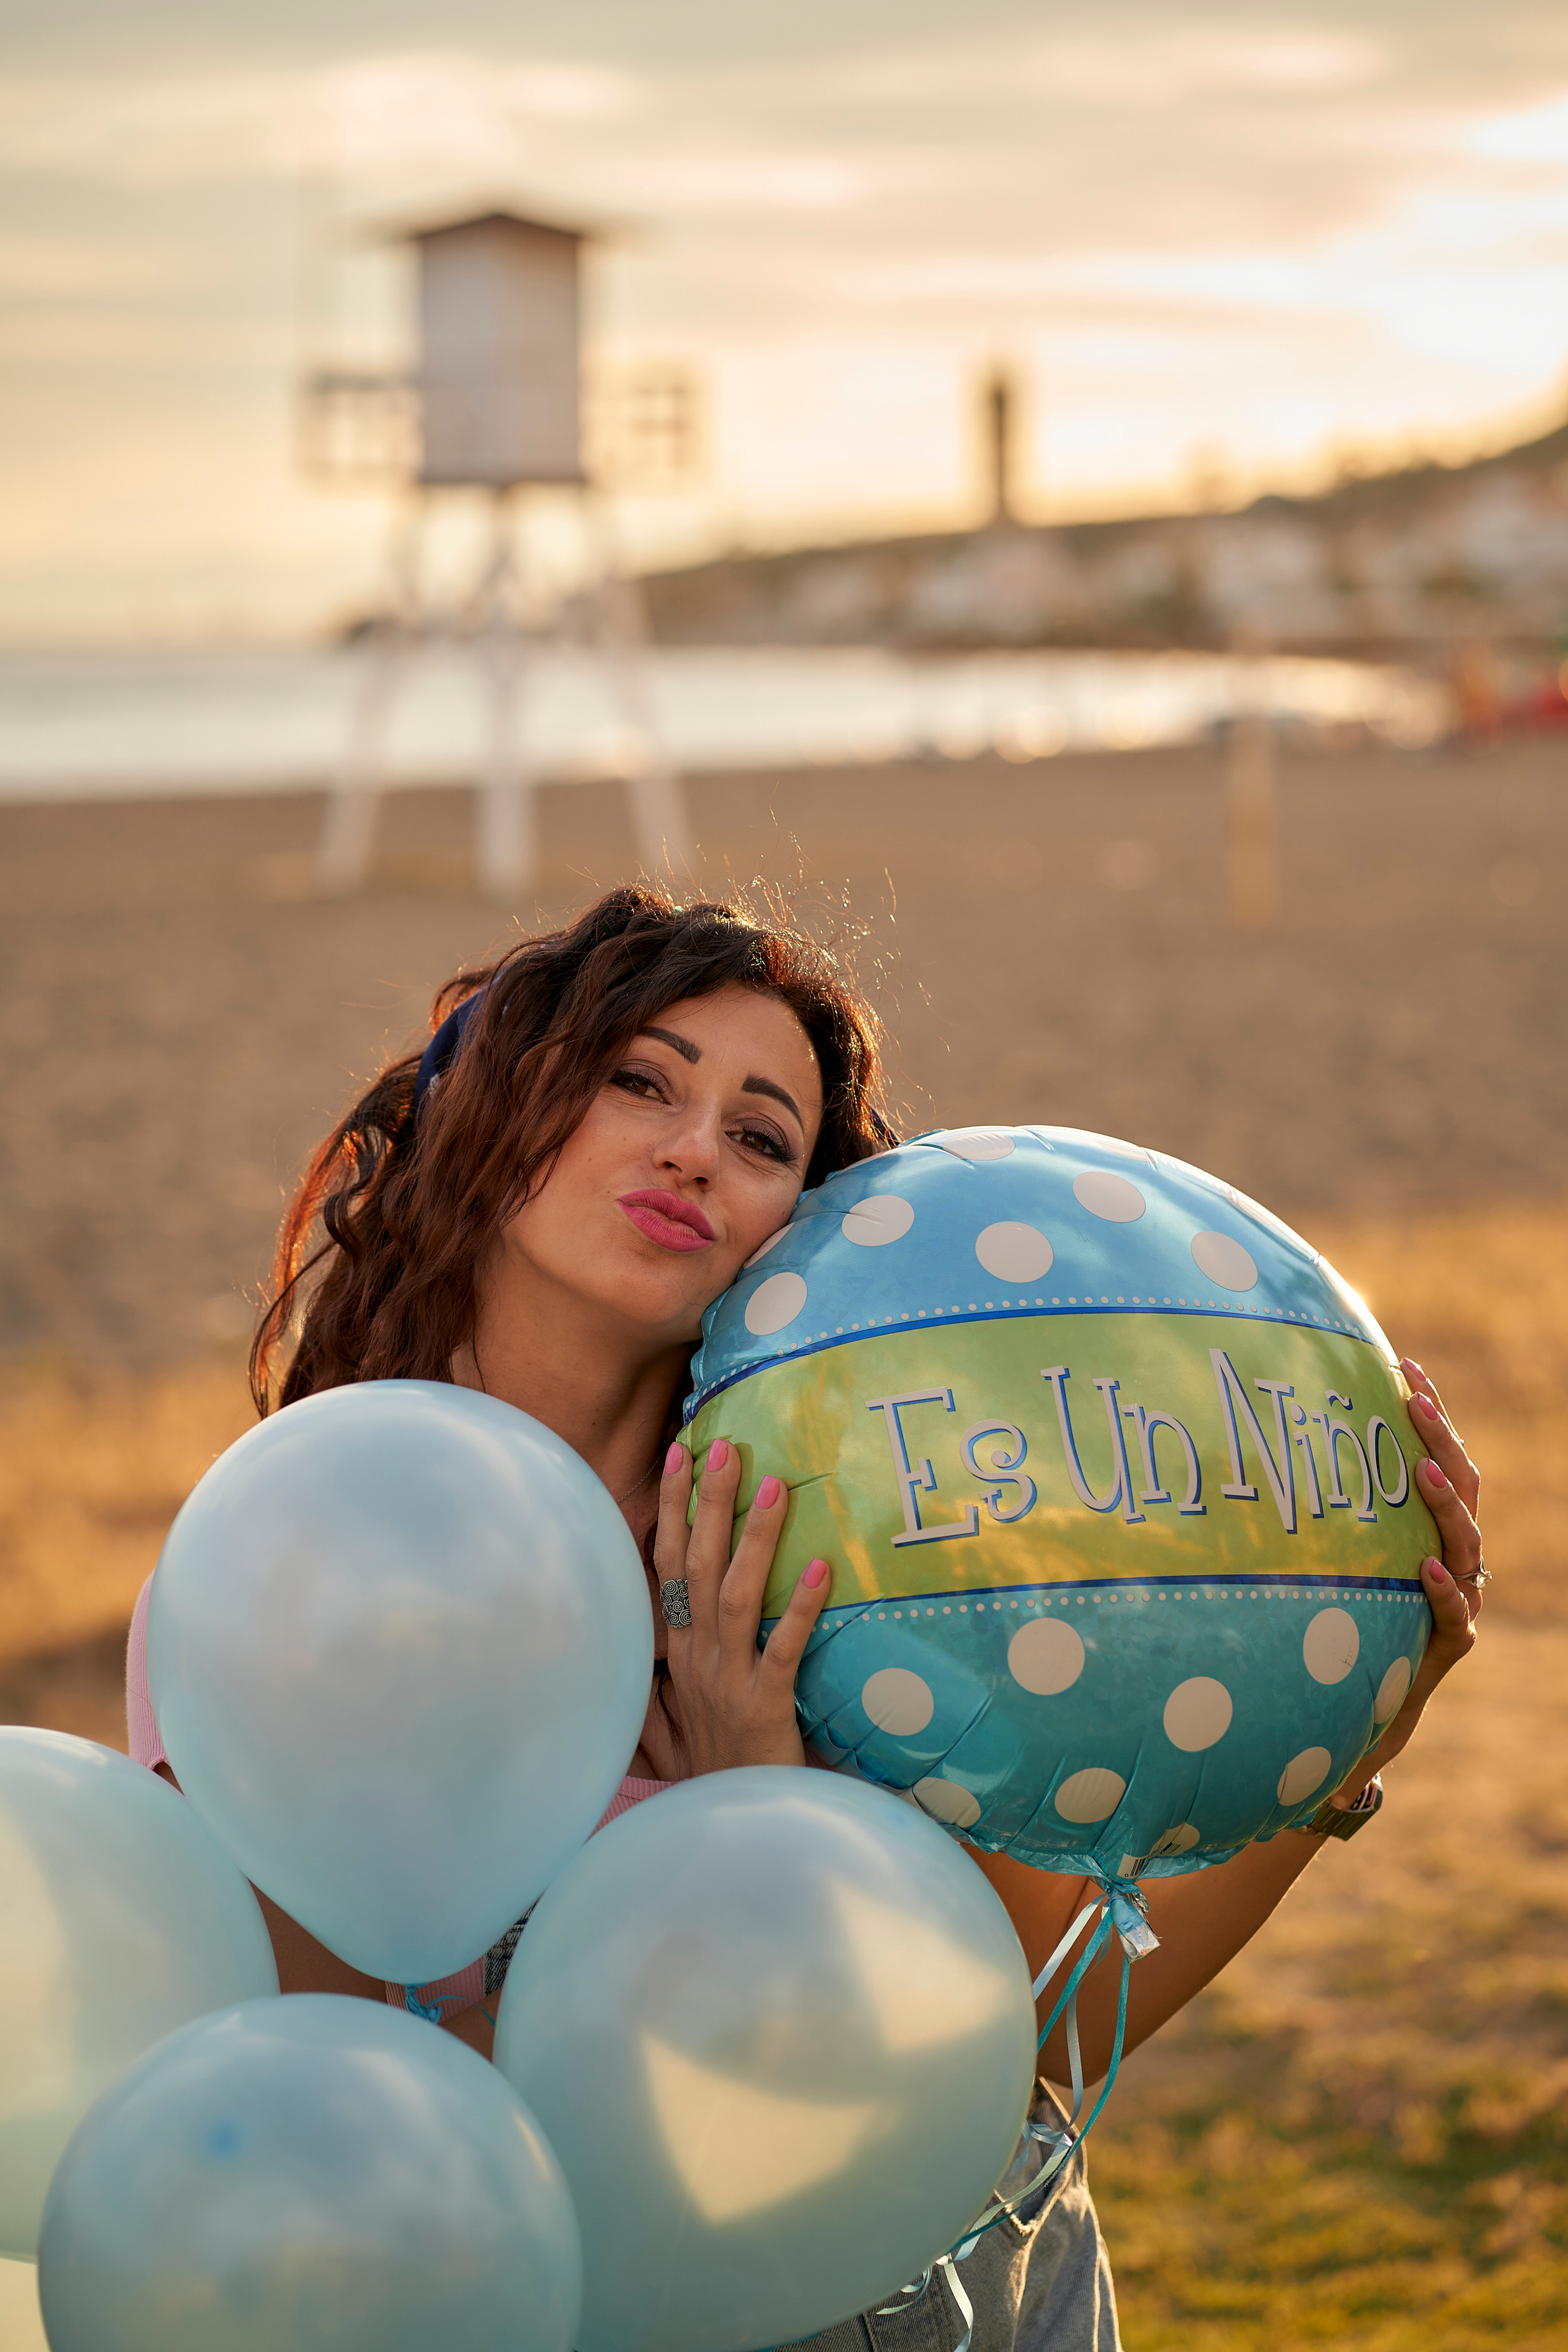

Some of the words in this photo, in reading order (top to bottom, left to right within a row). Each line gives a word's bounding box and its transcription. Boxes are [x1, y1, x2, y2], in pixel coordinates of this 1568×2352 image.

[864, 1387, 1037, 1548] Es
[1040, 1365, 1207, 1524] Un
[1209, 1348, 1409, 1534] Niño
